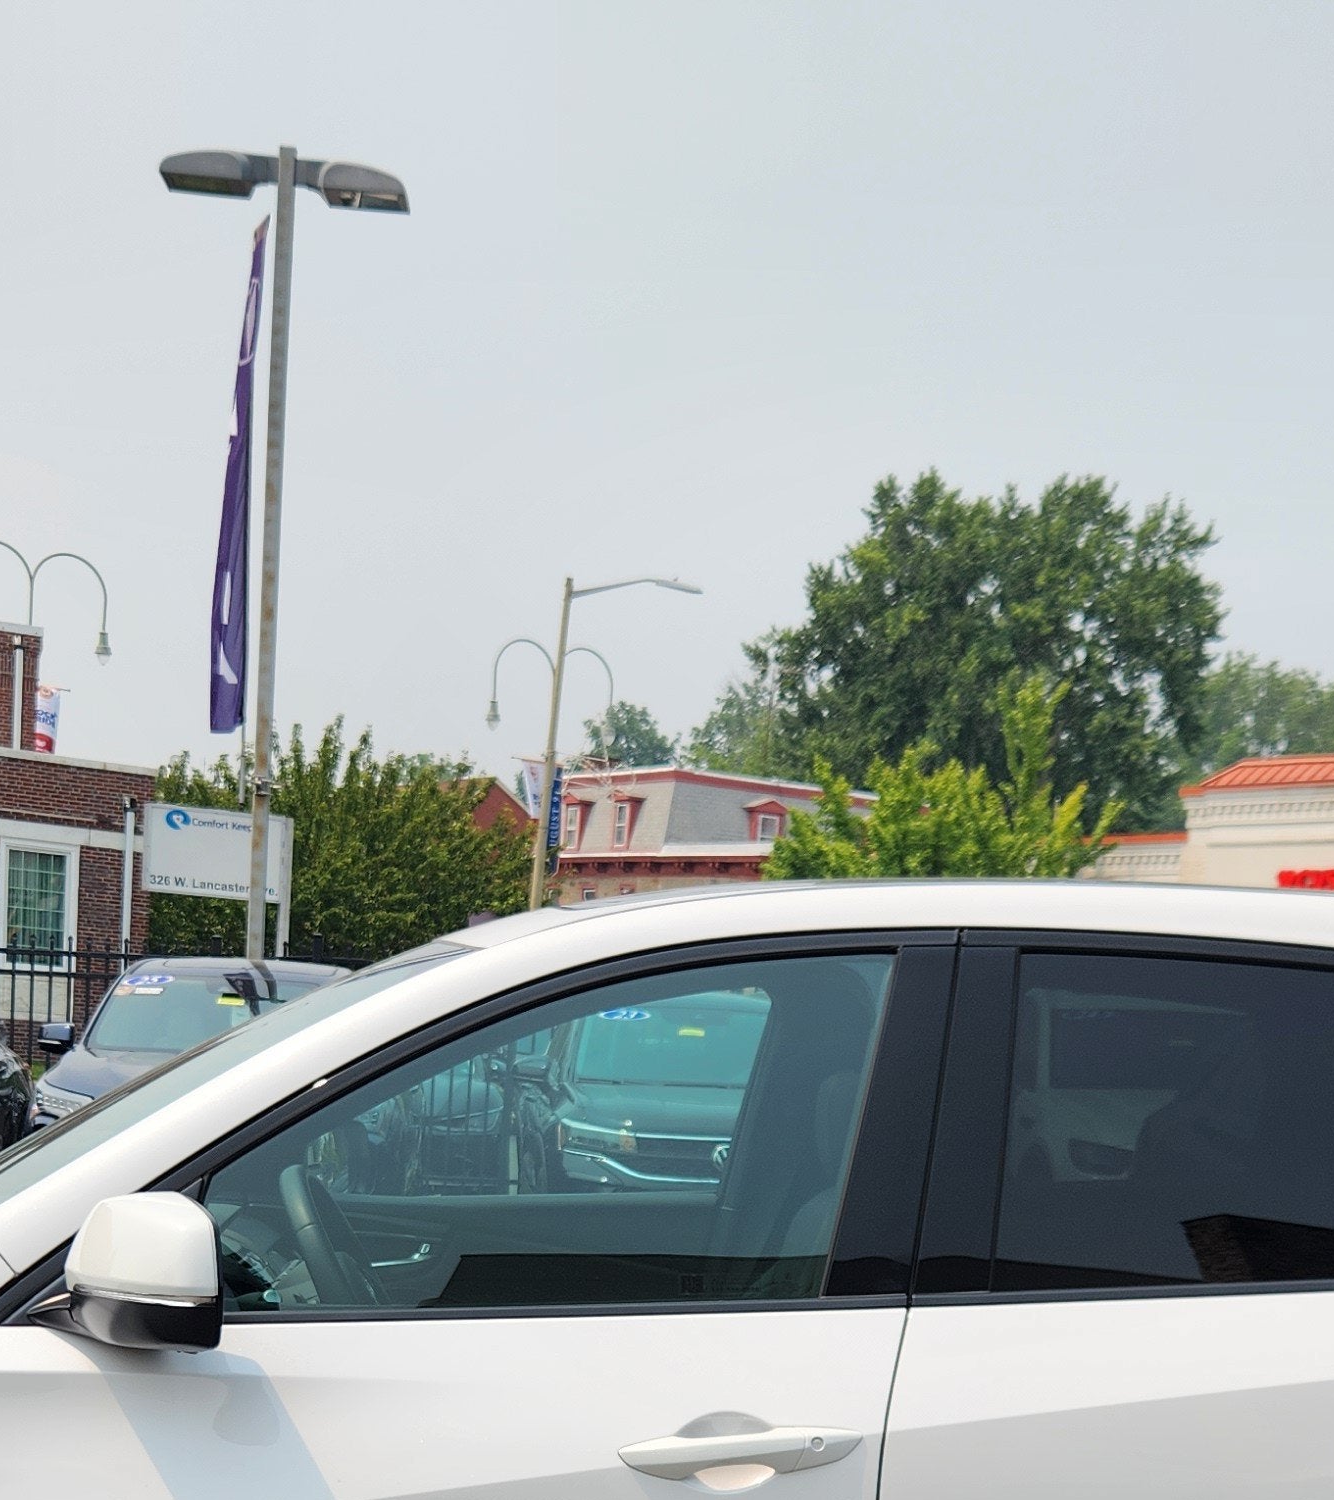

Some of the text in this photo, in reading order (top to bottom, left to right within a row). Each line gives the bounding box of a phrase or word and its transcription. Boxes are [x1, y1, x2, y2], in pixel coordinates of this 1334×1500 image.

[191, 817, 229, 830] Comfort
[149, 874, 171, 886] 326
[174, 876, 188, 888] W.
[192, 878, 250, 893] Lancaster
